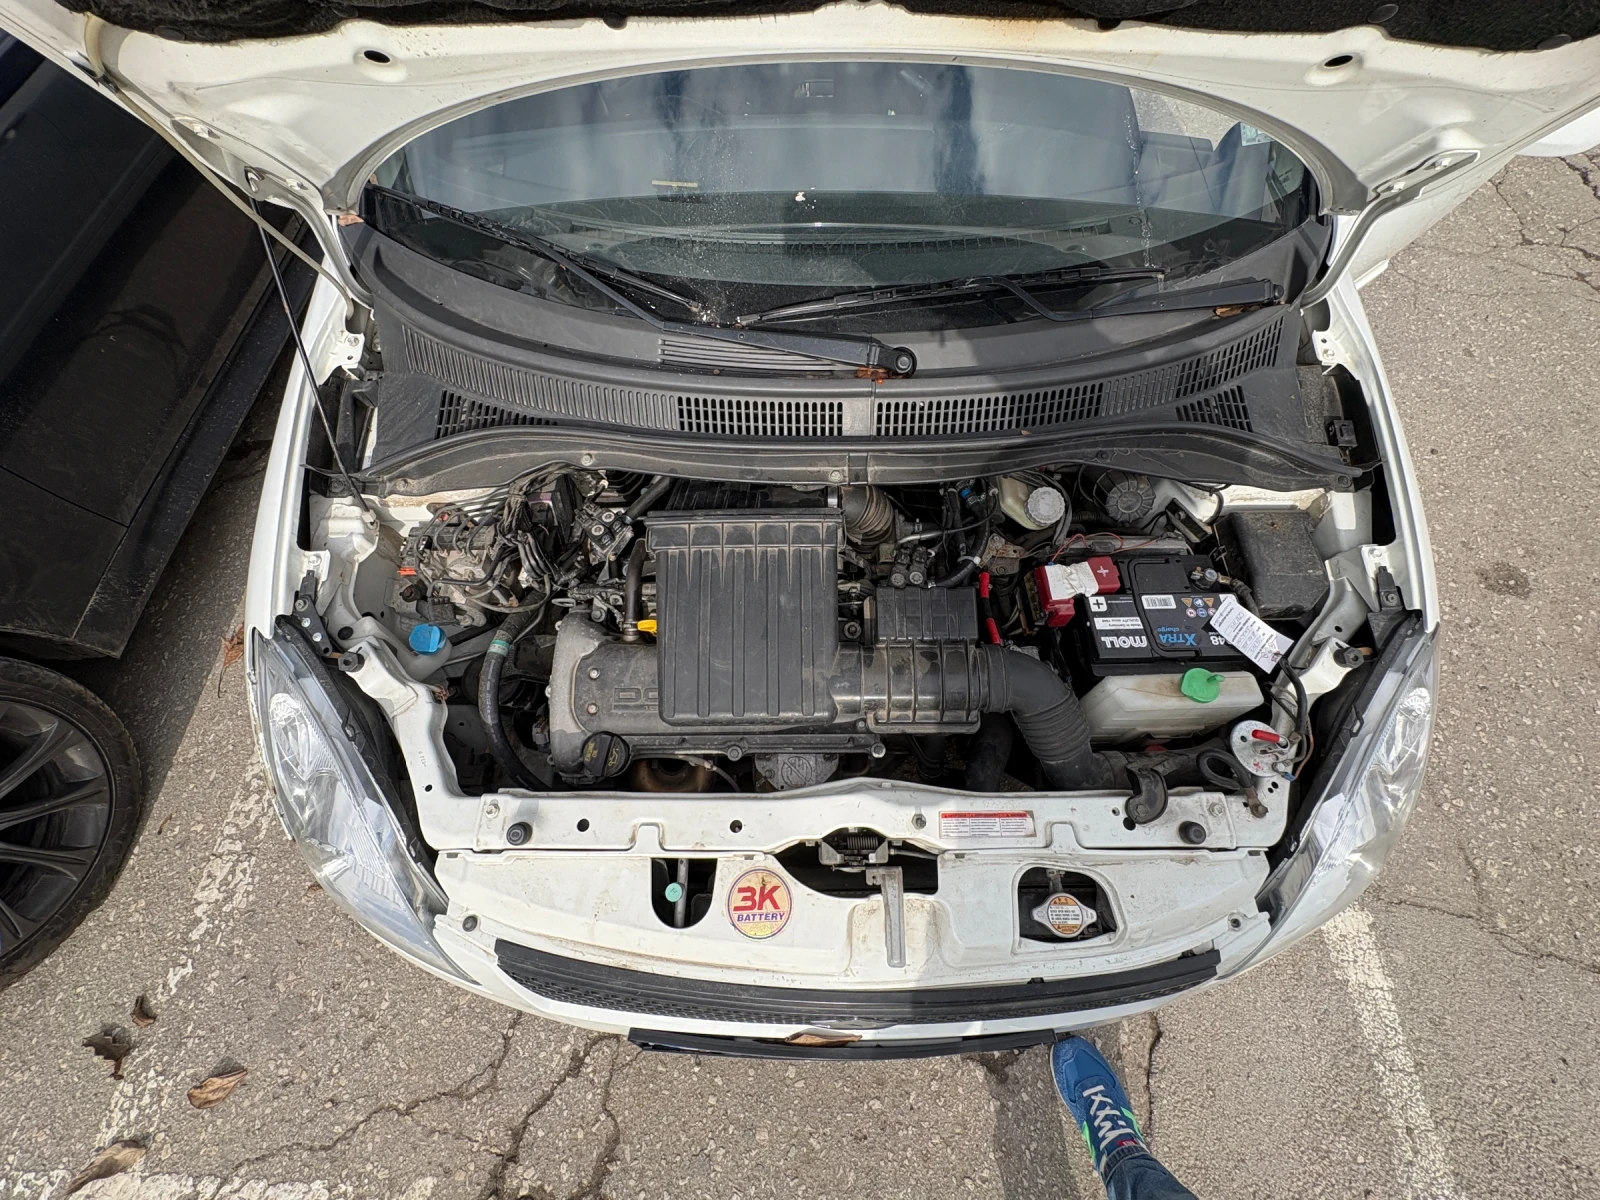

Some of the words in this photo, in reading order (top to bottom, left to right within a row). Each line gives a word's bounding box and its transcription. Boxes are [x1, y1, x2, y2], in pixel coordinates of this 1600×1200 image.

[1158, 633, 1197, 646] XTRA
[733, 886, 781, 912] 3K
[737, 912, 785, 922] BATTERY
